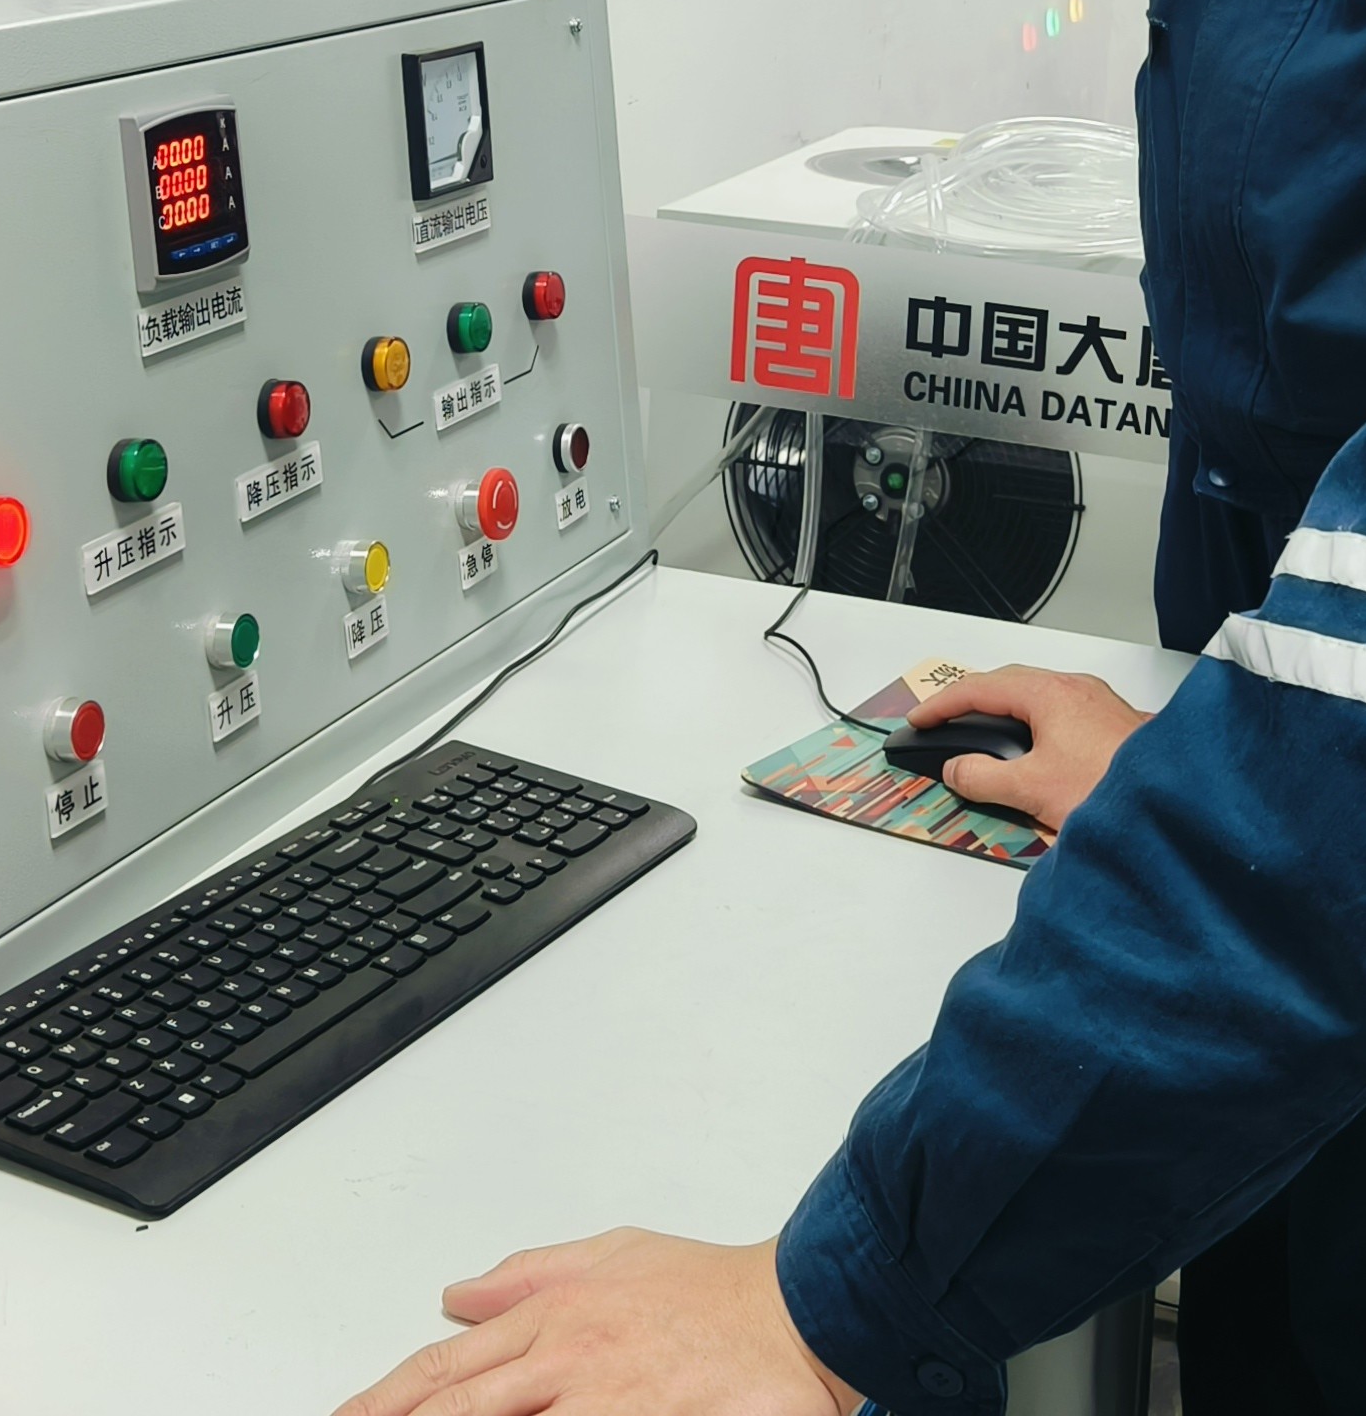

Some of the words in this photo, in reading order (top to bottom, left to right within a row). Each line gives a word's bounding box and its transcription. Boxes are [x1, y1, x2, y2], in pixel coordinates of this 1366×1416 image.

[415, 197, 489, 245] 直流输出电压
[145, 286, 243, 347] 负载输出电流
[441, 374, 496, 422] 输出指示
[246, 455, 317, 510] 降压指示
[561, 487, 587, 518] 放电
[93, 516, 178, 581] 升压指示
[465, 542, 495, 581] 急停
[351, 603, 385, 648] 降压
[216, 680, 257, 731] 升压
[55, 776, 103, 825] 停止
[279, 948, 294, 956] K
[121, 1008, 136, 1017] R
[221, 1023, 234, 1031] V
[59, 1044, 76, 1054] W
[136, 1037, 151, 1046] D
[191, 1041, 205, 1049] C
[27, 1066, 42, 1074] Q
[159, 1061, 175, 1070] X
[75, 1077, 89, 1085] A
[129, 1080, 145, 1090] Z
